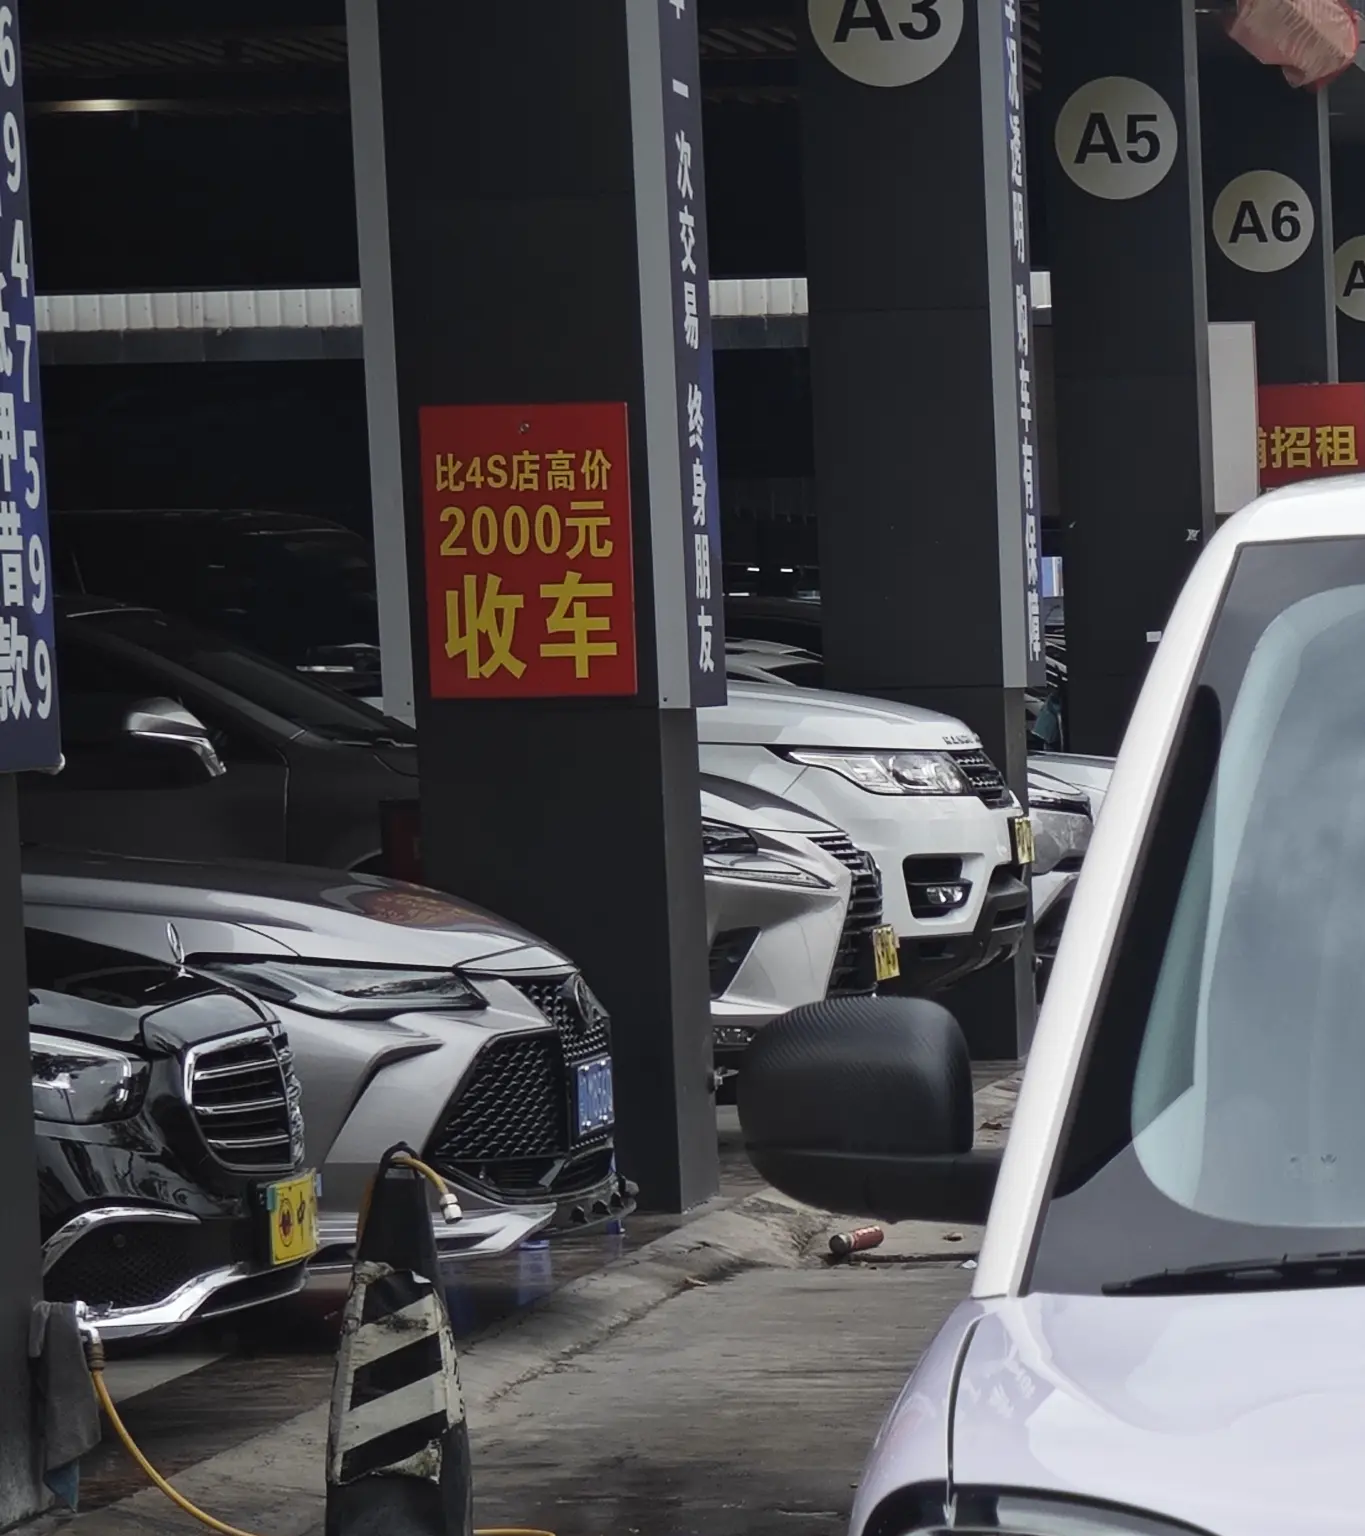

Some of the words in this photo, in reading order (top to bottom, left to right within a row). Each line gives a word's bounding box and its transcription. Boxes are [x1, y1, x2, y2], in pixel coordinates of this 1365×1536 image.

[832, 0, 941, 43] A3
[1074, 112, 1161, 165] A5
[1228, 200, 1301, 244] A6
[672, 78, 699, 350] 一次交易
[687, 383, 715, 673] 终身朋友
[435, 449, 612, 492] 比4S店高价
[439, 500, 614, 560] 2000元
[445, 570, 618, 680] 收车
